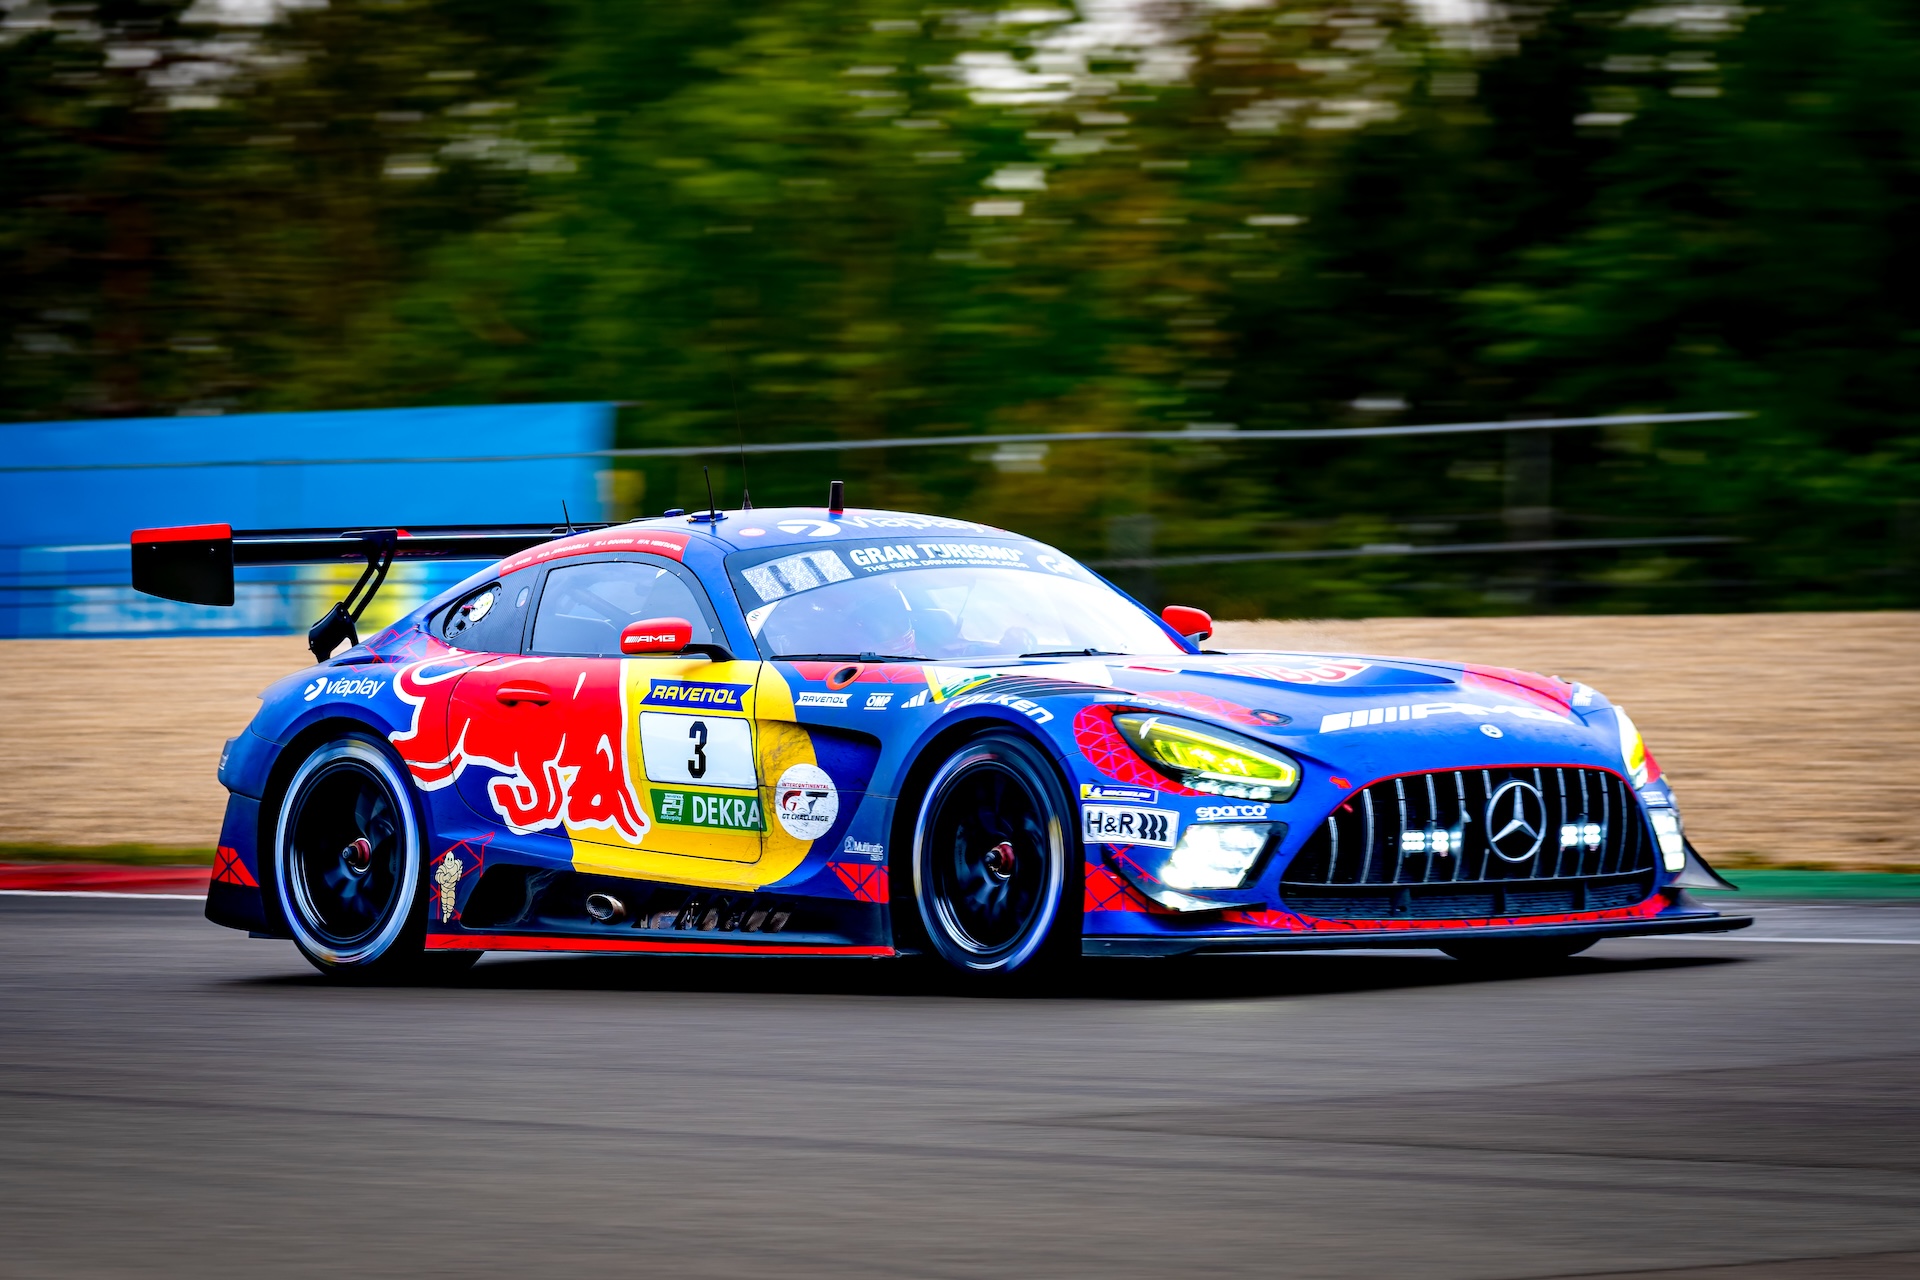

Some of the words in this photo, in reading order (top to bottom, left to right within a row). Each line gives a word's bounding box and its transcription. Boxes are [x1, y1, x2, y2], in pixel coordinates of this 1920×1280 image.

[849, 544, 919, 566] GRAN
[916, 543, 1021, 562] TURISMO
[863, 563, 890, 573] THE
[889, 560, 922, 570] REAL
[921, 559, 967, 567] DRIVING
[967, 558, 1030, 569] SIMULATOR
[637, 634, 676, 644] AMG
[326, 677, 387, 699] viaplay
[652, 685, 738, 705] RAVENOL
[801, 695, 845, 704] RAVENOL
[865, 695, 892, 707] OMP
[943, 693, 1055, 725] FALKEN
[687, 721, 708, 778] 3
[781, 782, 830, 790] INTERCONTINENTAL
[692, 795, 764, 829] DEKRA
[791, 813, 830, 822] CHALLENGE
[1195, 804, 1268, 821] sparco
[1086, 811, 1134, 835] H&R
